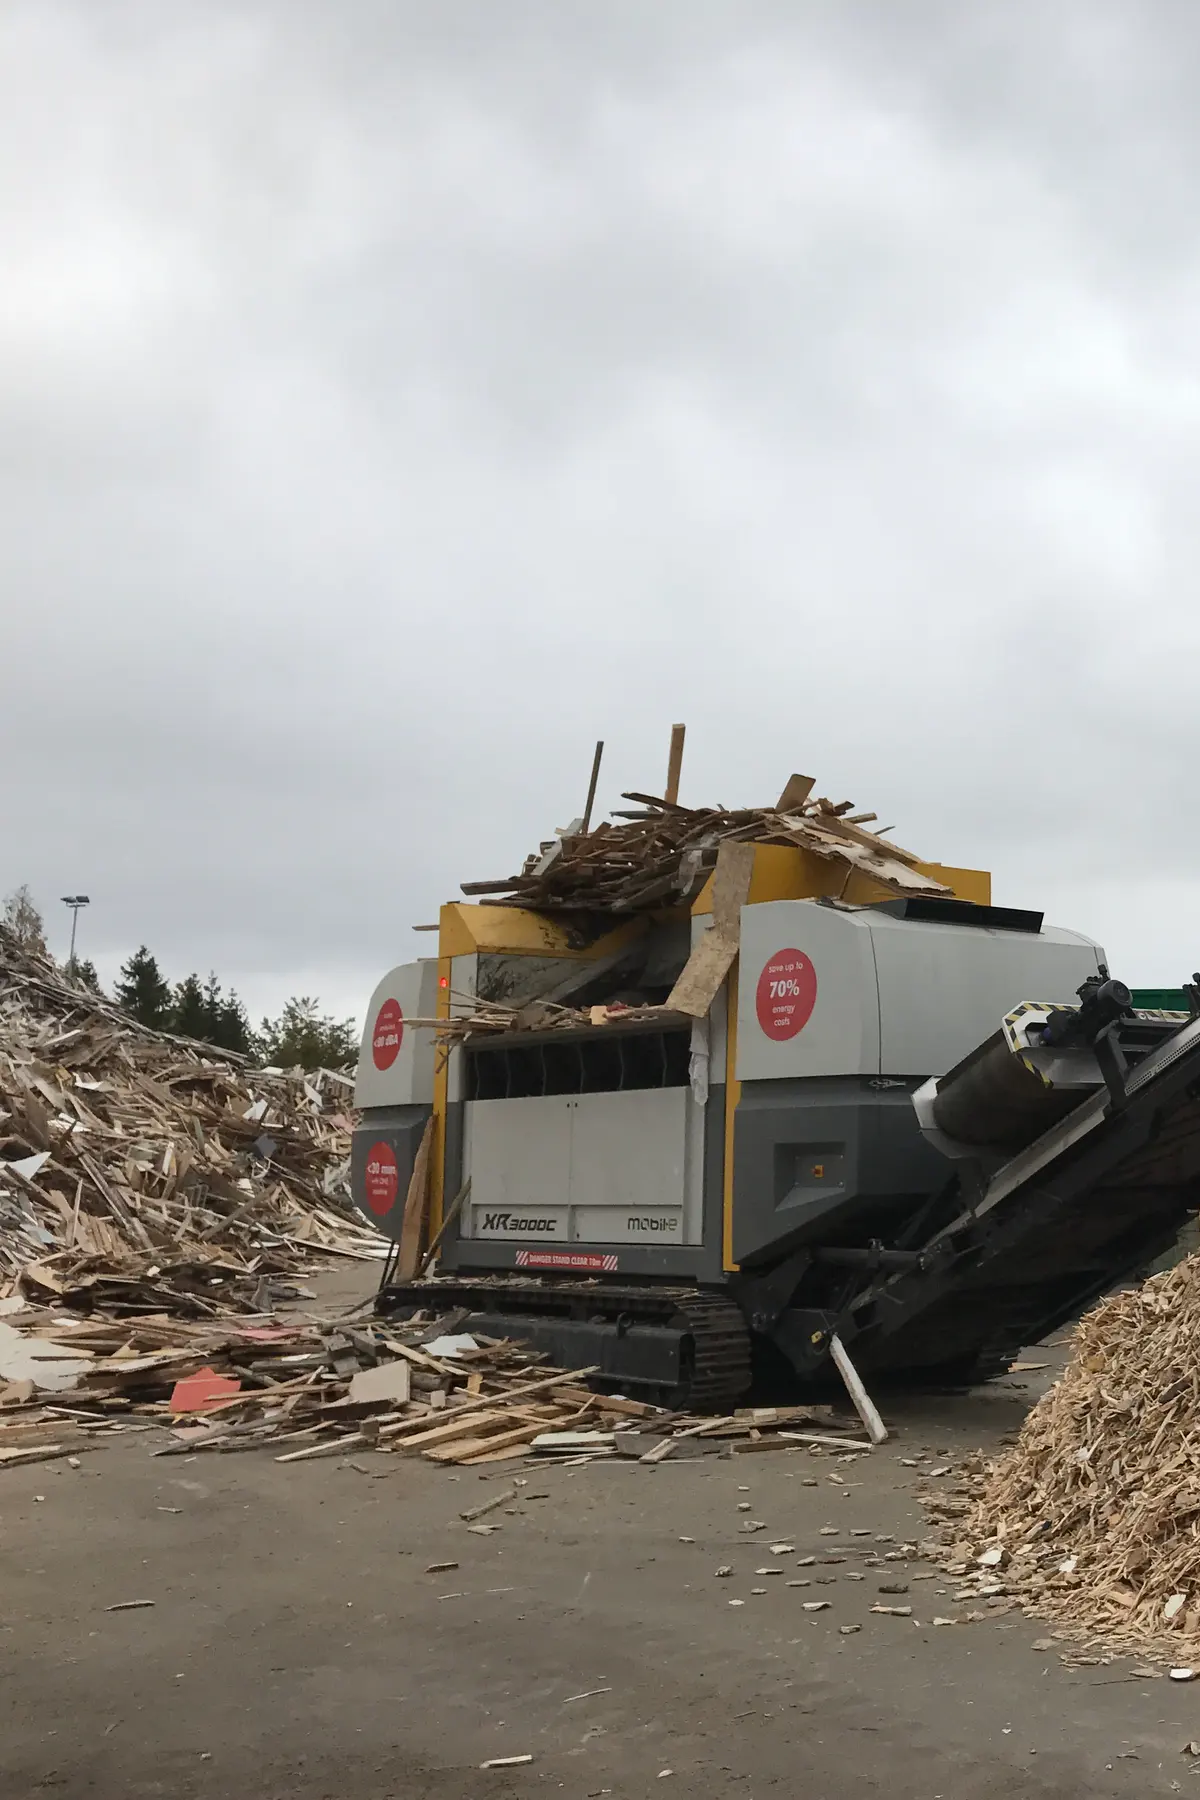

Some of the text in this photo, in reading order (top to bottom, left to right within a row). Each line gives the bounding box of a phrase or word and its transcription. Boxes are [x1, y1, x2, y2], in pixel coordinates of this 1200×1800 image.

[768, 961, 803, 973] save up to
[769, 979, 800, 999] 70%
[772, 1004, 796, 1015] energy
[774, 1016, 790, 1026] costs
[529, 1254, 552, 1264] DANGER
[552, 1255, 571, 1265] STAND
[571, 1256, 588, 1266] CLEAR
